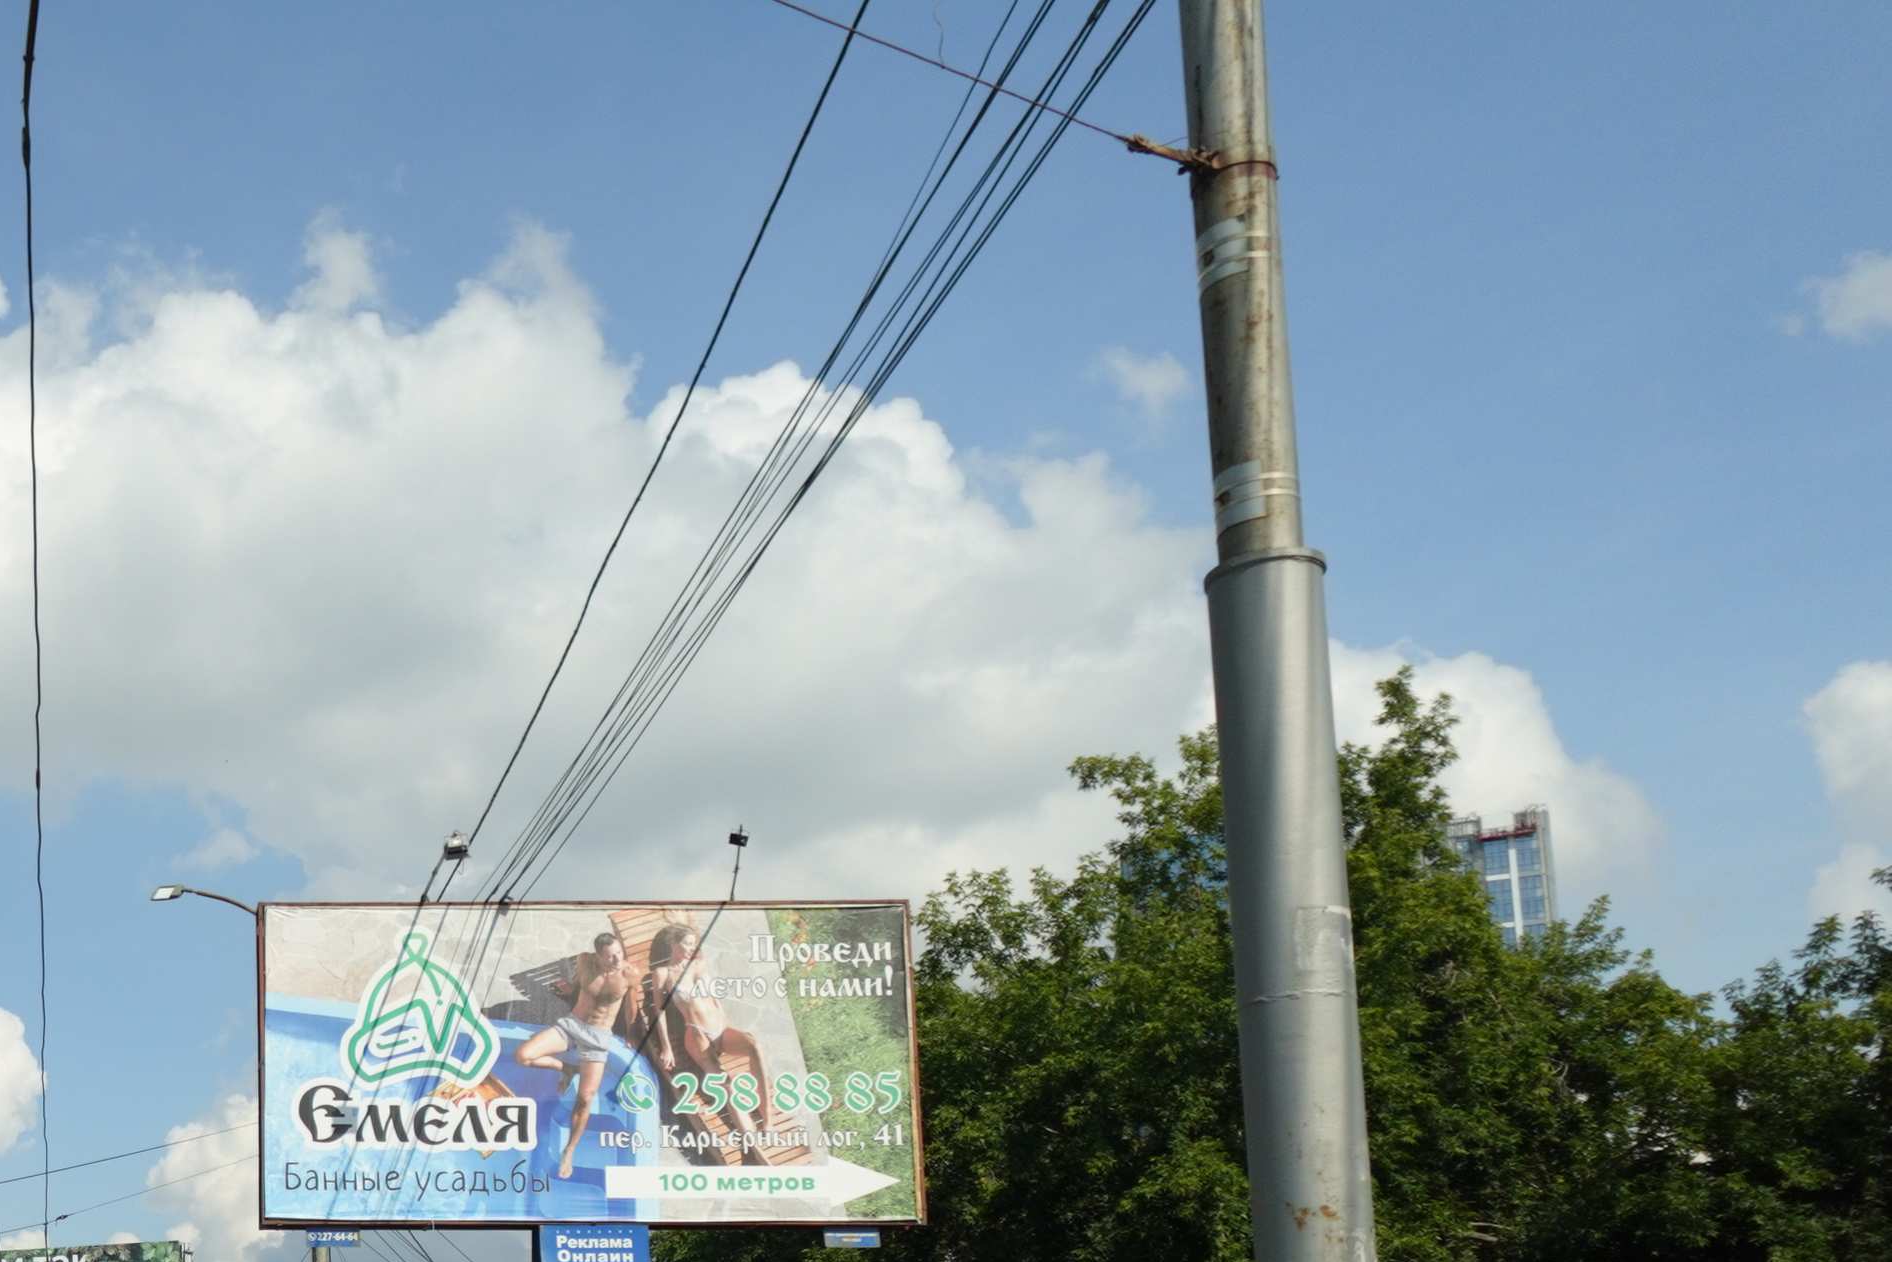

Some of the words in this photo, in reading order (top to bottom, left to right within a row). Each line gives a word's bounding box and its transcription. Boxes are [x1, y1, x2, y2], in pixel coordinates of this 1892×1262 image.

[749, 934, 893, 970] Проведи
[690, 977, 767, 998] лето
[774, 979, 788, 997] с
[799, 965, 894, 998] нами!
[672, 1072, 760, 1114] 258
[773, 1072, 833, 1113] 88
[844, 1071, 901, 1113] 85
[298, 1084, 530, 1146] Емеля
[599, 1130, 652, 1153] пер.
[660, 1125, 809, 1154] Карьерный
[817, 1130, 866, 1151] лог,
[874, 1123, 905, 1147] 41
[285, 1162, 402, 1191] Банные
[415, 1160, 551, 1201] усадьбы
[659, 1173, 708, 1191] 100
[716, 1176, 816, 1194] метров
[555, 1234, 634, 1249] Реклама
